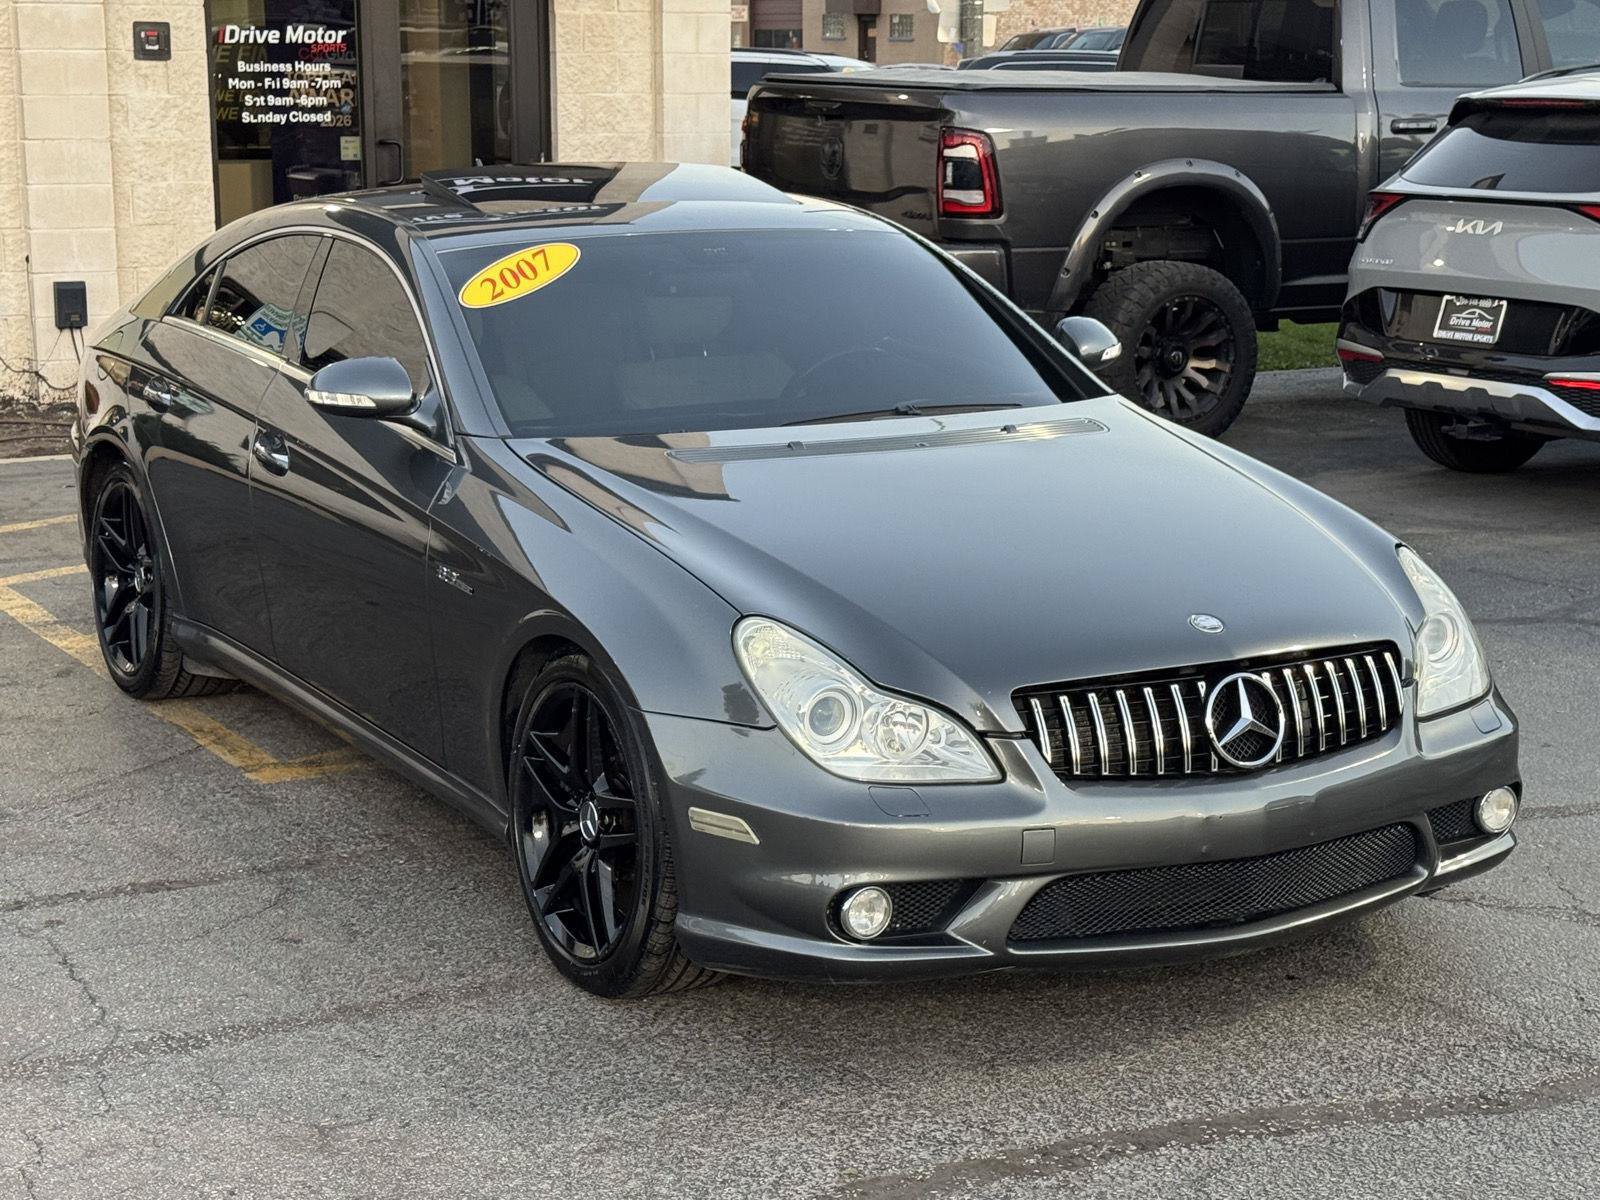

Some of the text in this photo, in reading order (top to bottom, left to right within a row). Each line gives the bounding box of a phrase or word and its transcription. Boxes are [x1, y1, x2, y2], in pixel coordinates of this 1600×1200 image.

[285, 25, 347, 44] Motor
[311, 43, 347, 53] SPORTS
[237, 61, 331, 73] Business Hours
[228, 78, 255, 90] Mon
[282, 78, 308, 90] 9am
[267, 95, 294, 107] 9am
[289, 110, 332, 123] Closed
[1455, 218, 1503, 235] KIA
[480, 248, 551, 301] 2007
[1449, 316, 1494, 328] Drive Motor
